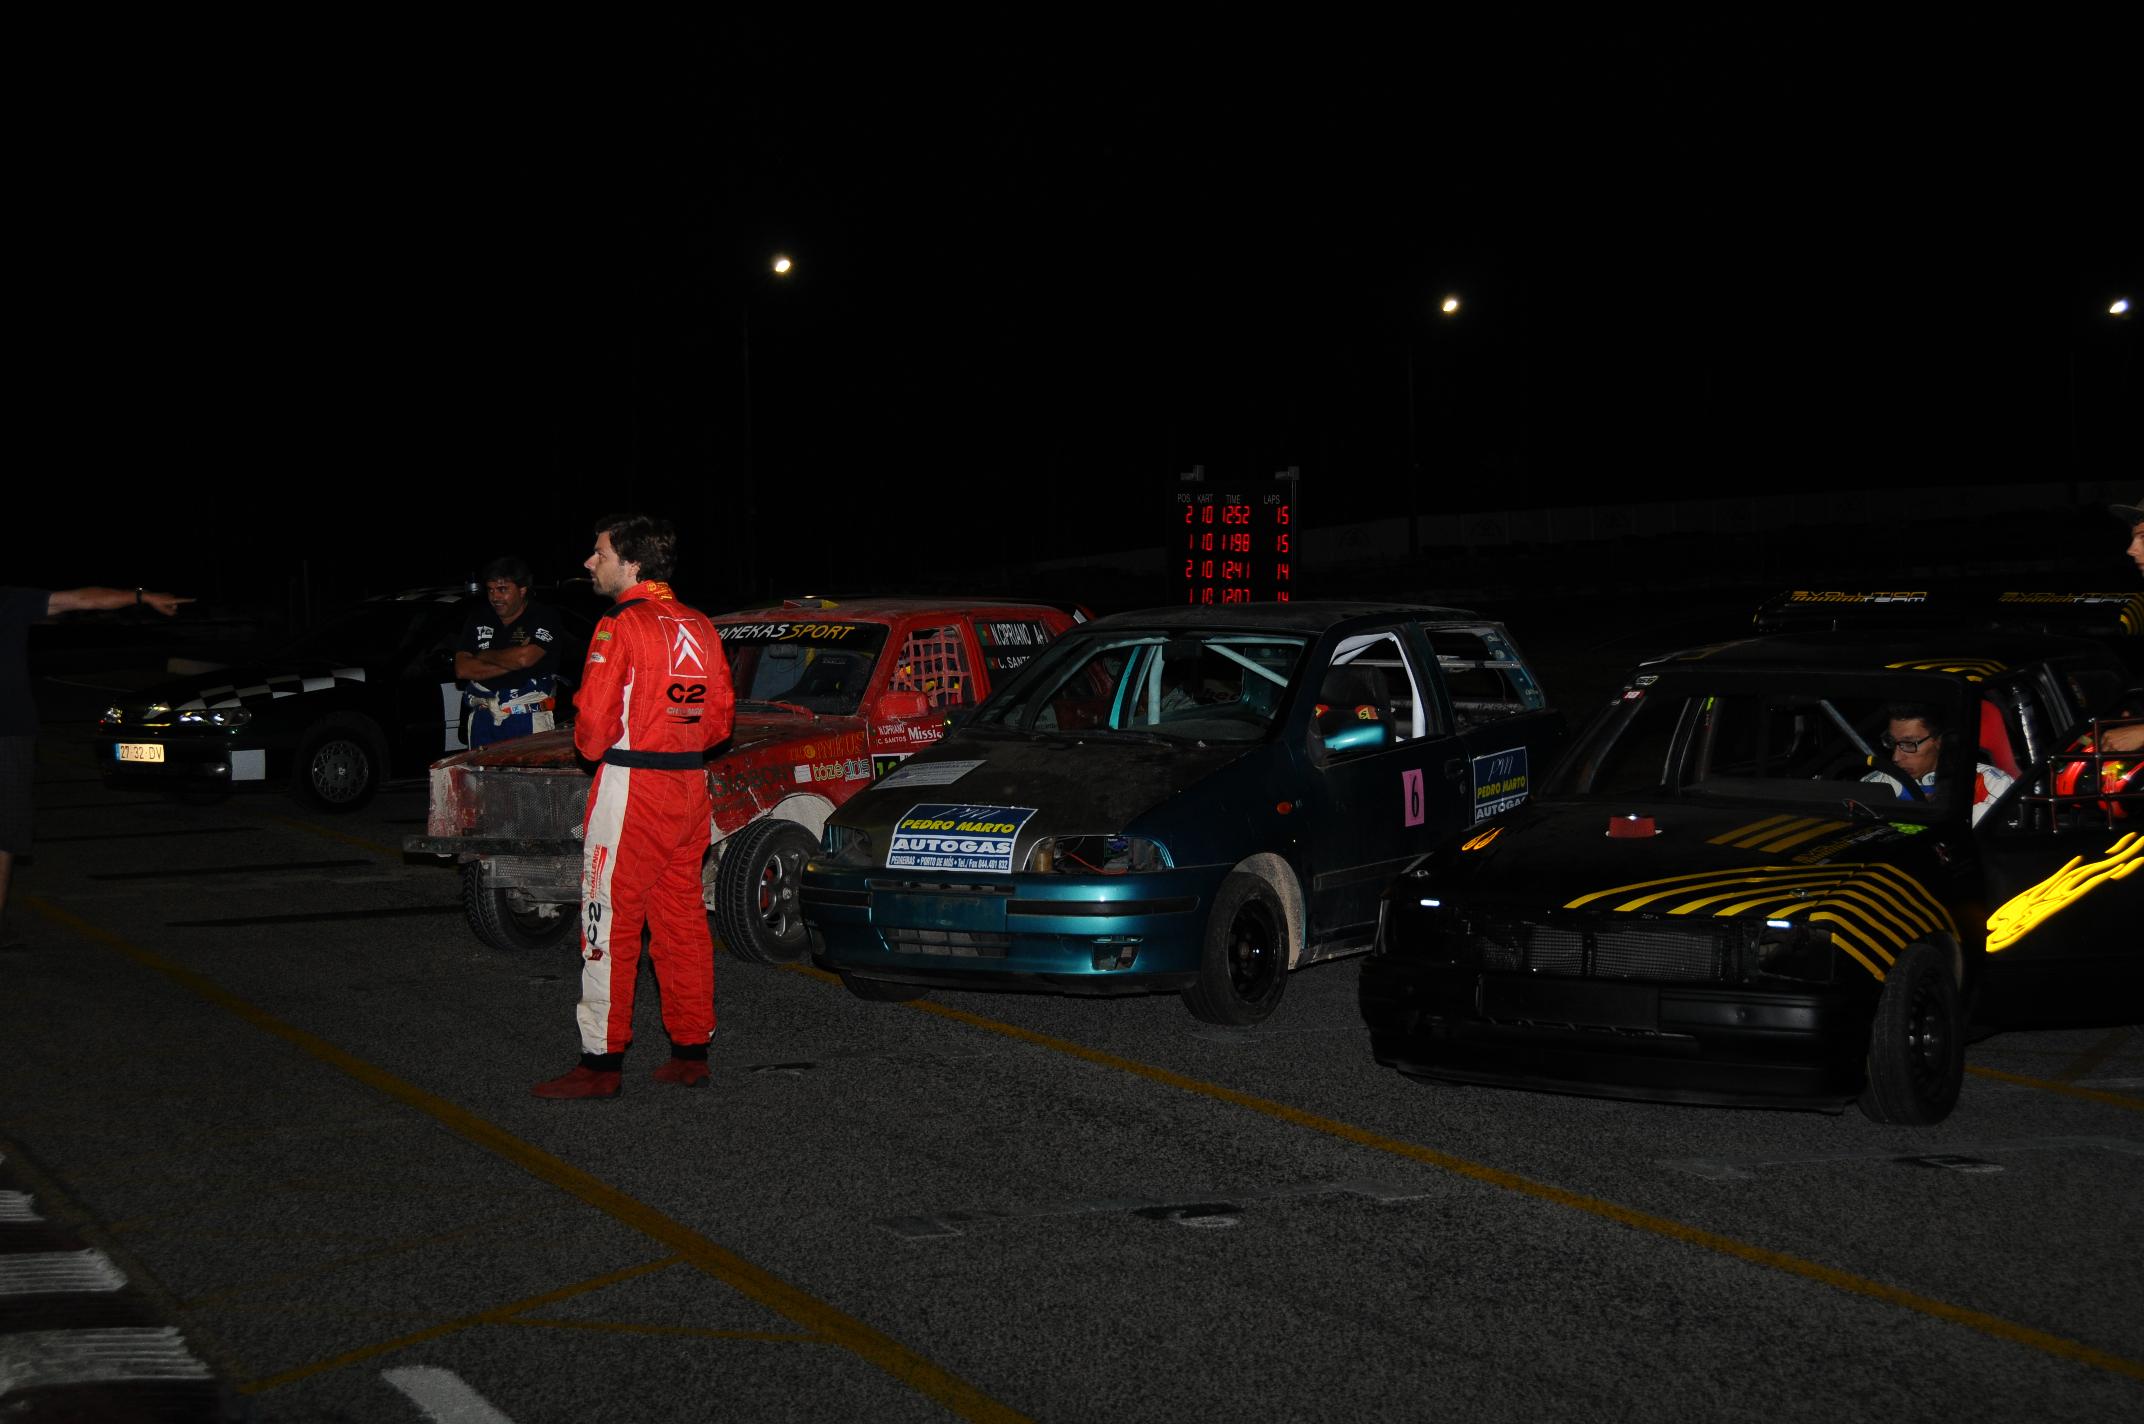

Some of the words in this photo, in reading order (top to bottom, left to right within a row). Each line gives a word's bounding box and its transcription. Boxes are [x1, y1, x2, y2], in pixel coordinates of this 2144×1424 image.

[1225, 494, 1241, 504] TIME
[1263, 494, 1281, 505] LAPS
[1185, 505, 1194, 525] 2
[1201, 505, 1214, 525] 10
[1276, 505, 1290, 525] 15
[1201, 533, 1214, 552] 10
[1276, 534, 1290, 553] 15
[1185, 560, 1194, 578] 2
[1201, 560, 1214, 579] 10
[1276, 562, 1290, 581] 14
[779, 623, 856, 641] SPORT
[666, 683, 707, 704] C2
[1411, 775, 1420, 818] 6
[1476, 782, 1502, 799] PEDRO
[1503, 775, 1527, 793] MARTO
[899, 818, 956, 831] PEDRO
[956, 821, 1016, 834] MARTO
[891, 838, 1011, 854] AUTOGAS
[589, 843, 602, 899] CHALLENGE
[920, 856, 936, 867] PORTO
[936, 857, 943, 866] DE
[587, 902, 601, 946] C2
